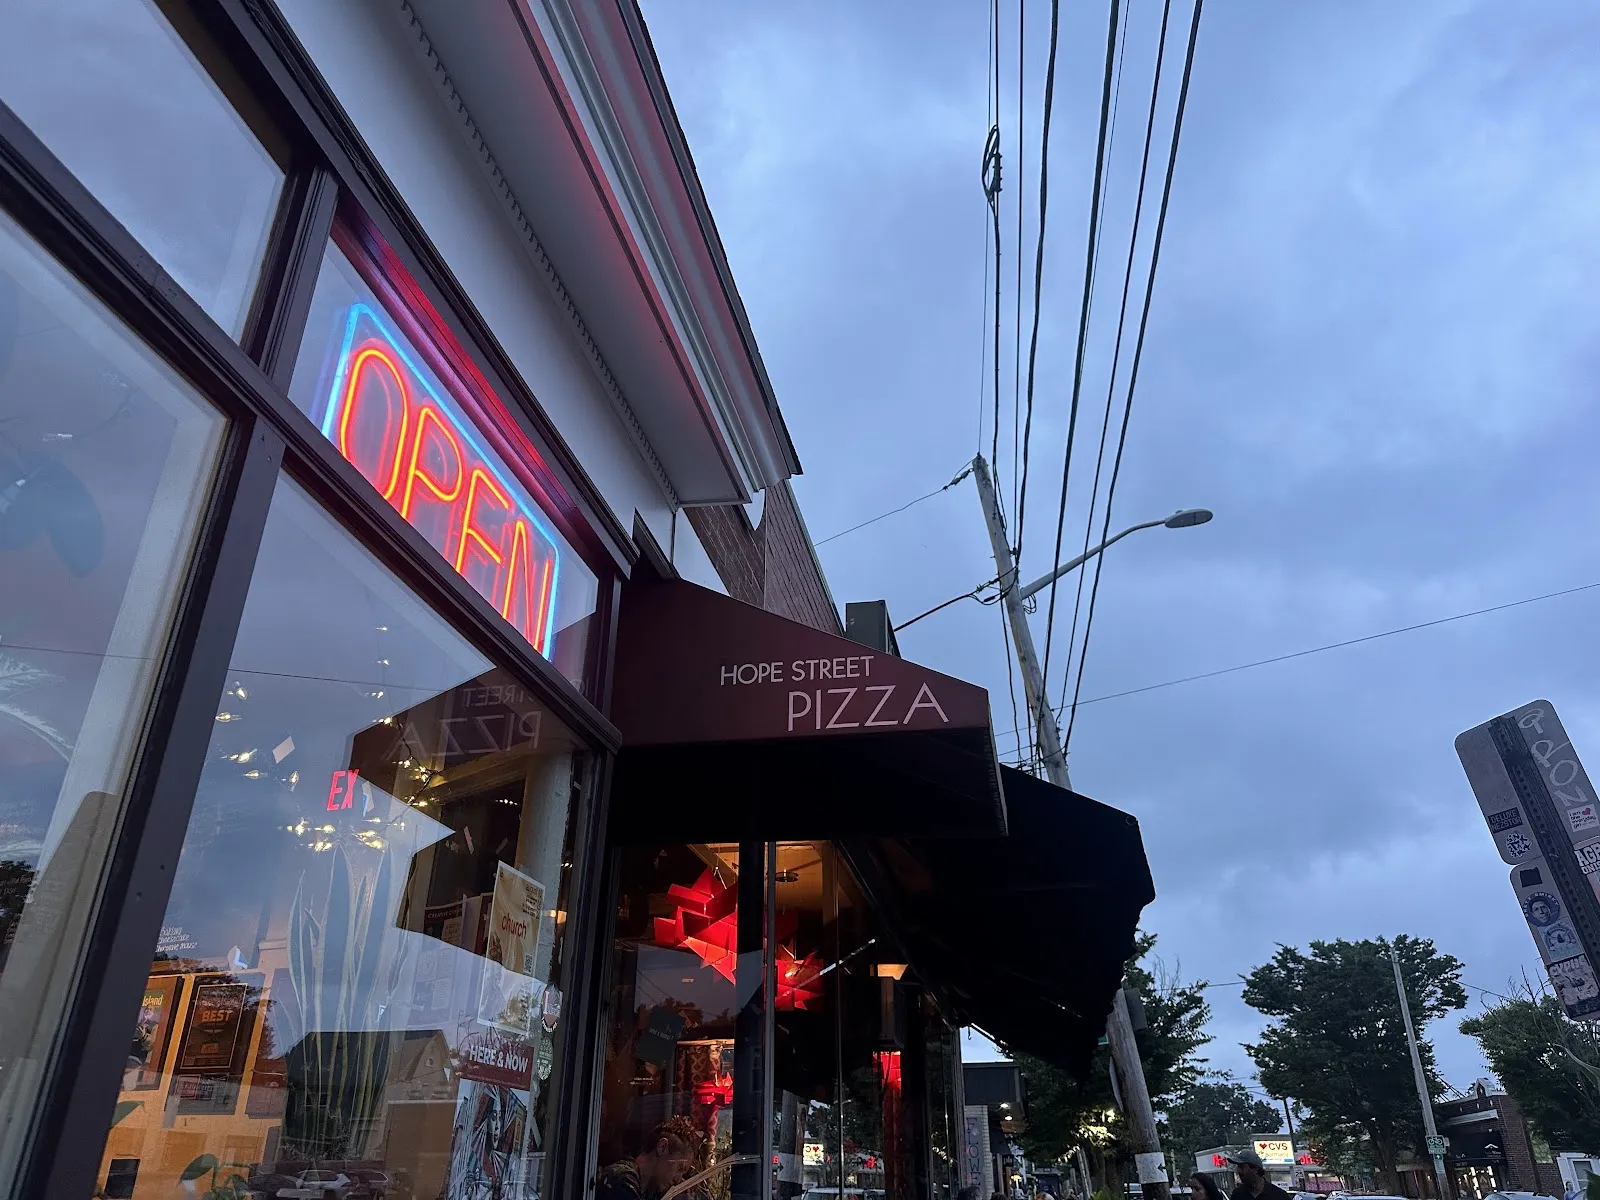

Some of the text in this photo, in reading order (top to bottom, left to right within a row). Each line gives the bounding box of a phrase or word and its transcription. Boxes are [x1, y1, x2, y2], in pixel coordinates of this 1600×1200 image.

[340, 345, 552, 653] OPEN
[720, 655, 875, 686] HOPE STREET
[787, 682, 950, 732] PIZZA
[501, 912, 528, 940] church
[142, 994, 164, 1007] Island
[201, 1009, 234, 1022] BEST
[469, 1044, 497, 1066] HERE
[496, 1051, 504, 1068] &
[504, 1052, 529, 1073] NOW
[1268, 1142, 1288, 1151] CVS
